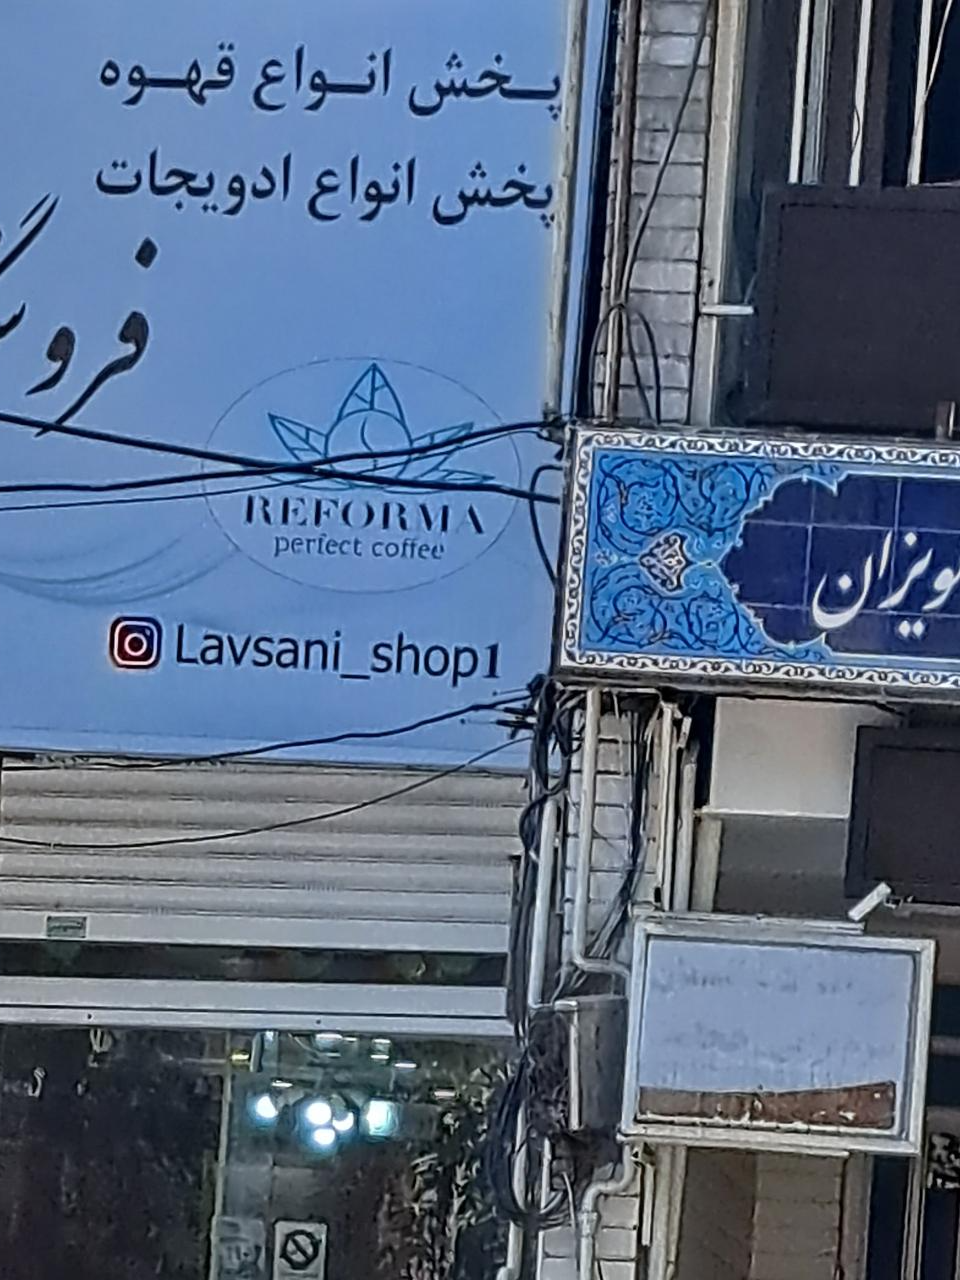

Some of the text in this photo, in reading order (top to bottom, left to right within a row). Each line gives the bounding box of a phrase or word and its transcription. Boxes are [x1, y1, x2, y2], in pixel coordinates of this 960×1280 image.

[100, 43, 562, 120] پخش انواع قهوه
[96, 149, 555, 229] پخش انواع ادویجات
[245, 494, 484, 536] REFORMA
[274, 534, 445, 560] perfect coffee
[812, 529, 960, 638] ویزان
[176, 624, 500, 682] Lavsani_shop1
